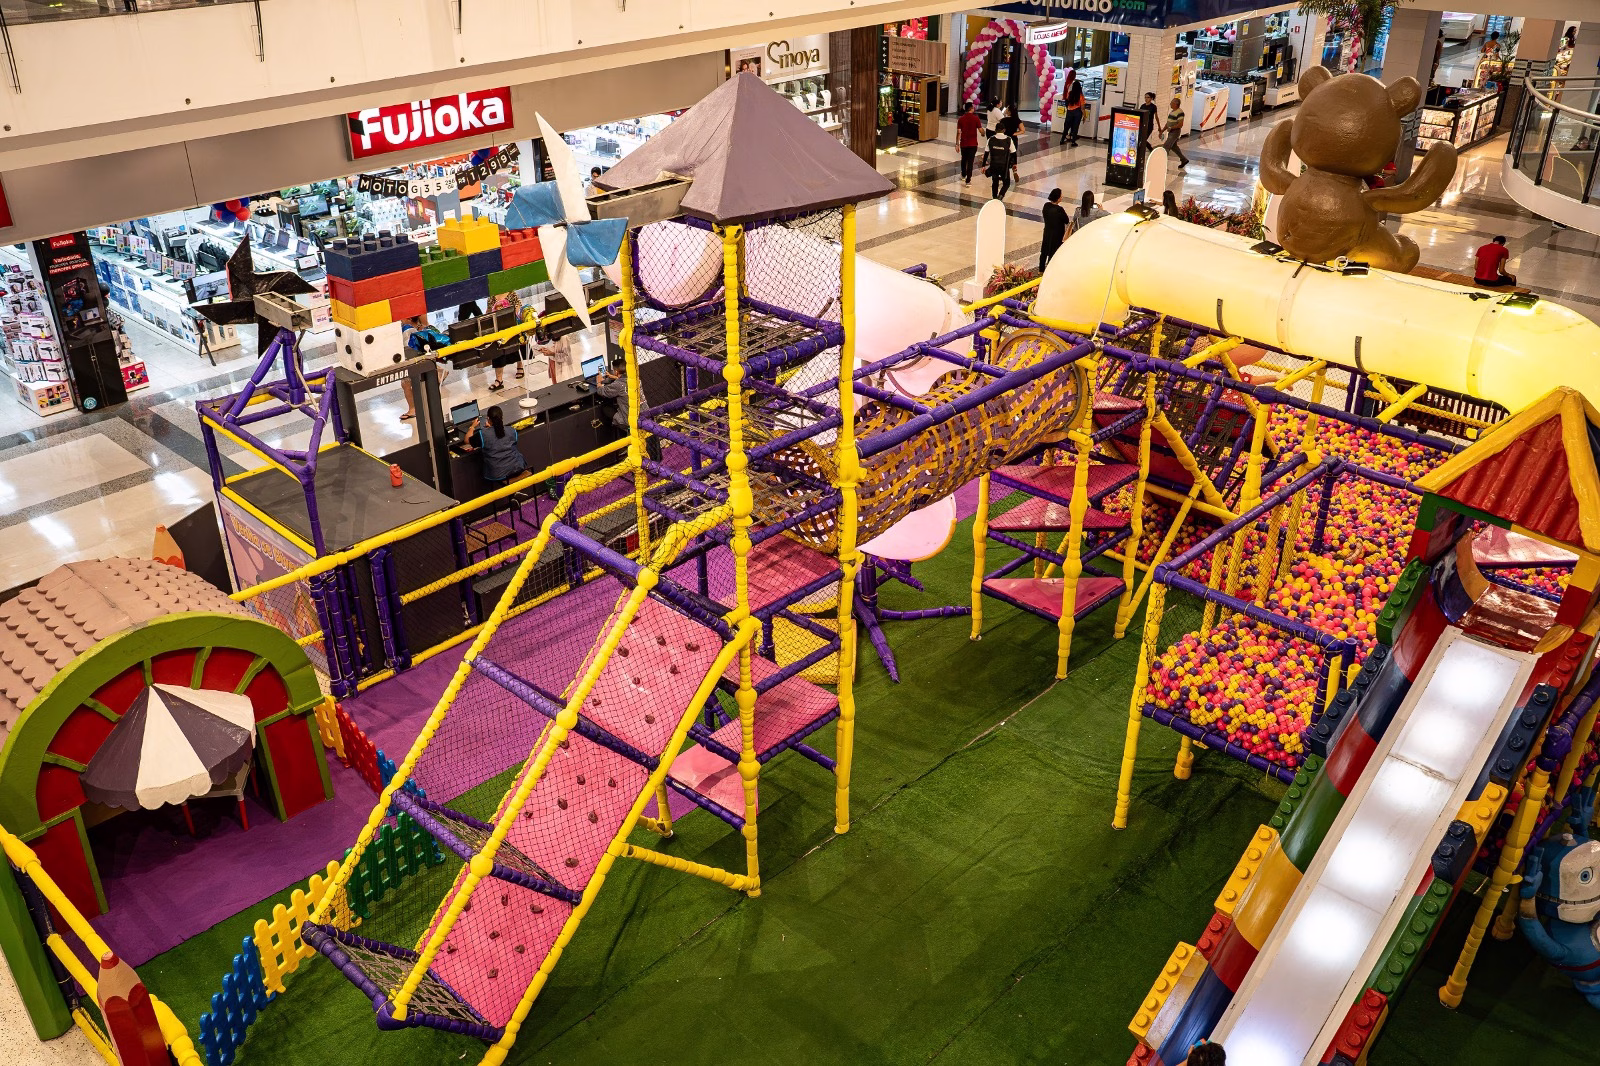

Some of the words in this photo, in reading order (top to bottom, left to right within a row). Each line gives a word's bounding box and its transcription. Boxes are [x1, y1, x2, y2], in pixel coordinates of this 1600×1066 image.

[778, 47, 820, 70] moya
[357, 92, 505, 150] Fujioka
[360, 179, 408, 194] MOTO
[376, 369, 409, 387] ENTRADA
